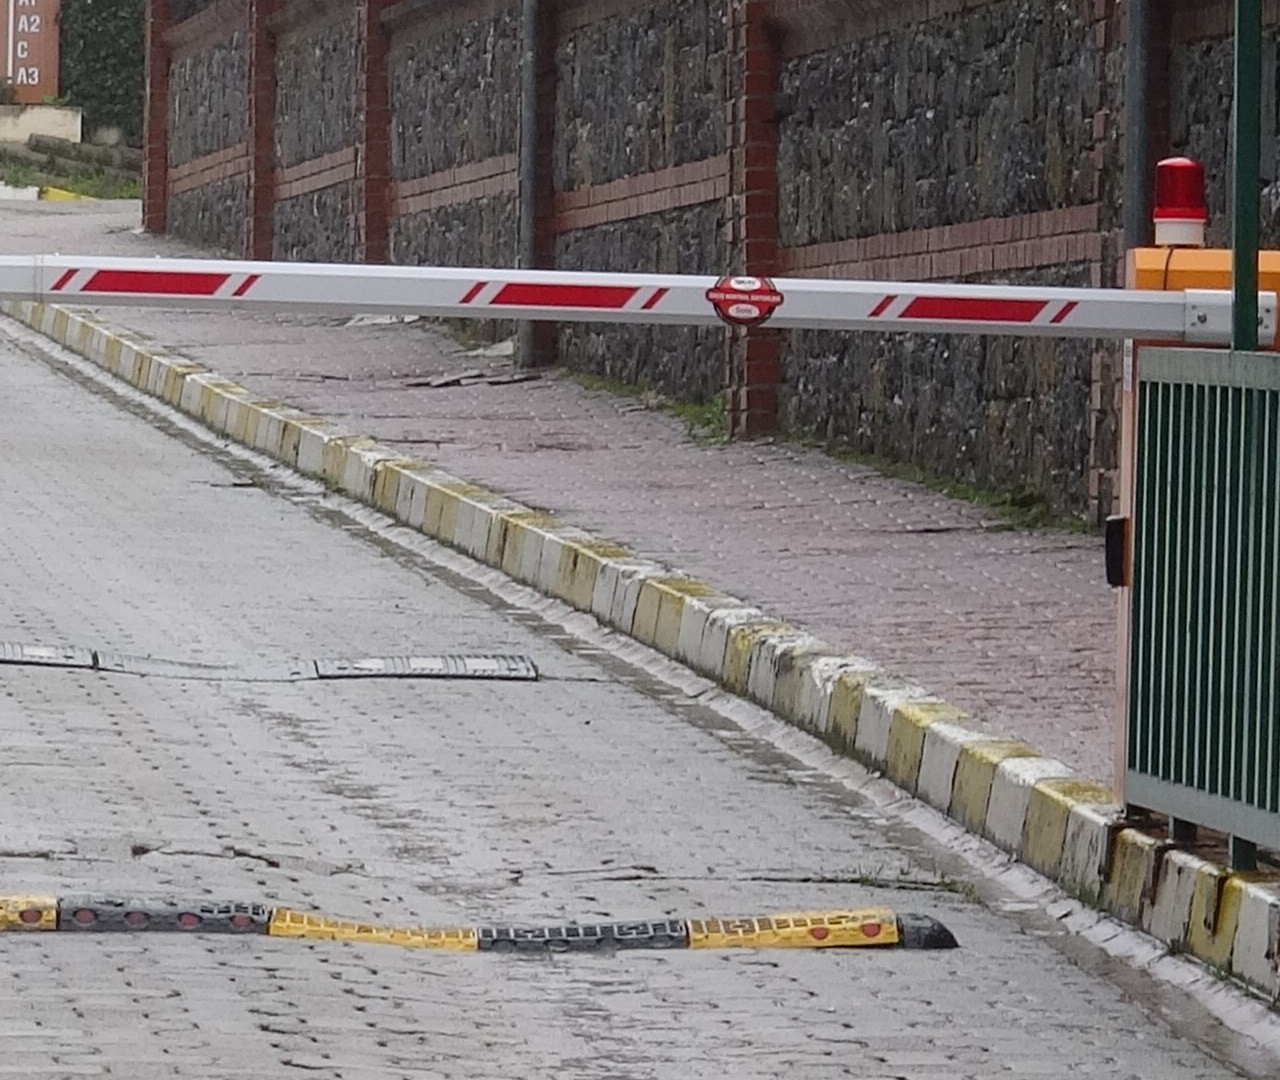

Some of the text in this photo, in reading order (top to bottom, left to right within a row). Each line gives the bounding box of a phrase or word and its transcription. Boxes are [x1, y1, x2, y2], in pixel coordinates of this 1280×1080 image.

[18, 15, 40, 32] A2
[17, 41, 28, 58] C
[17, 67, 39, 85] A3
